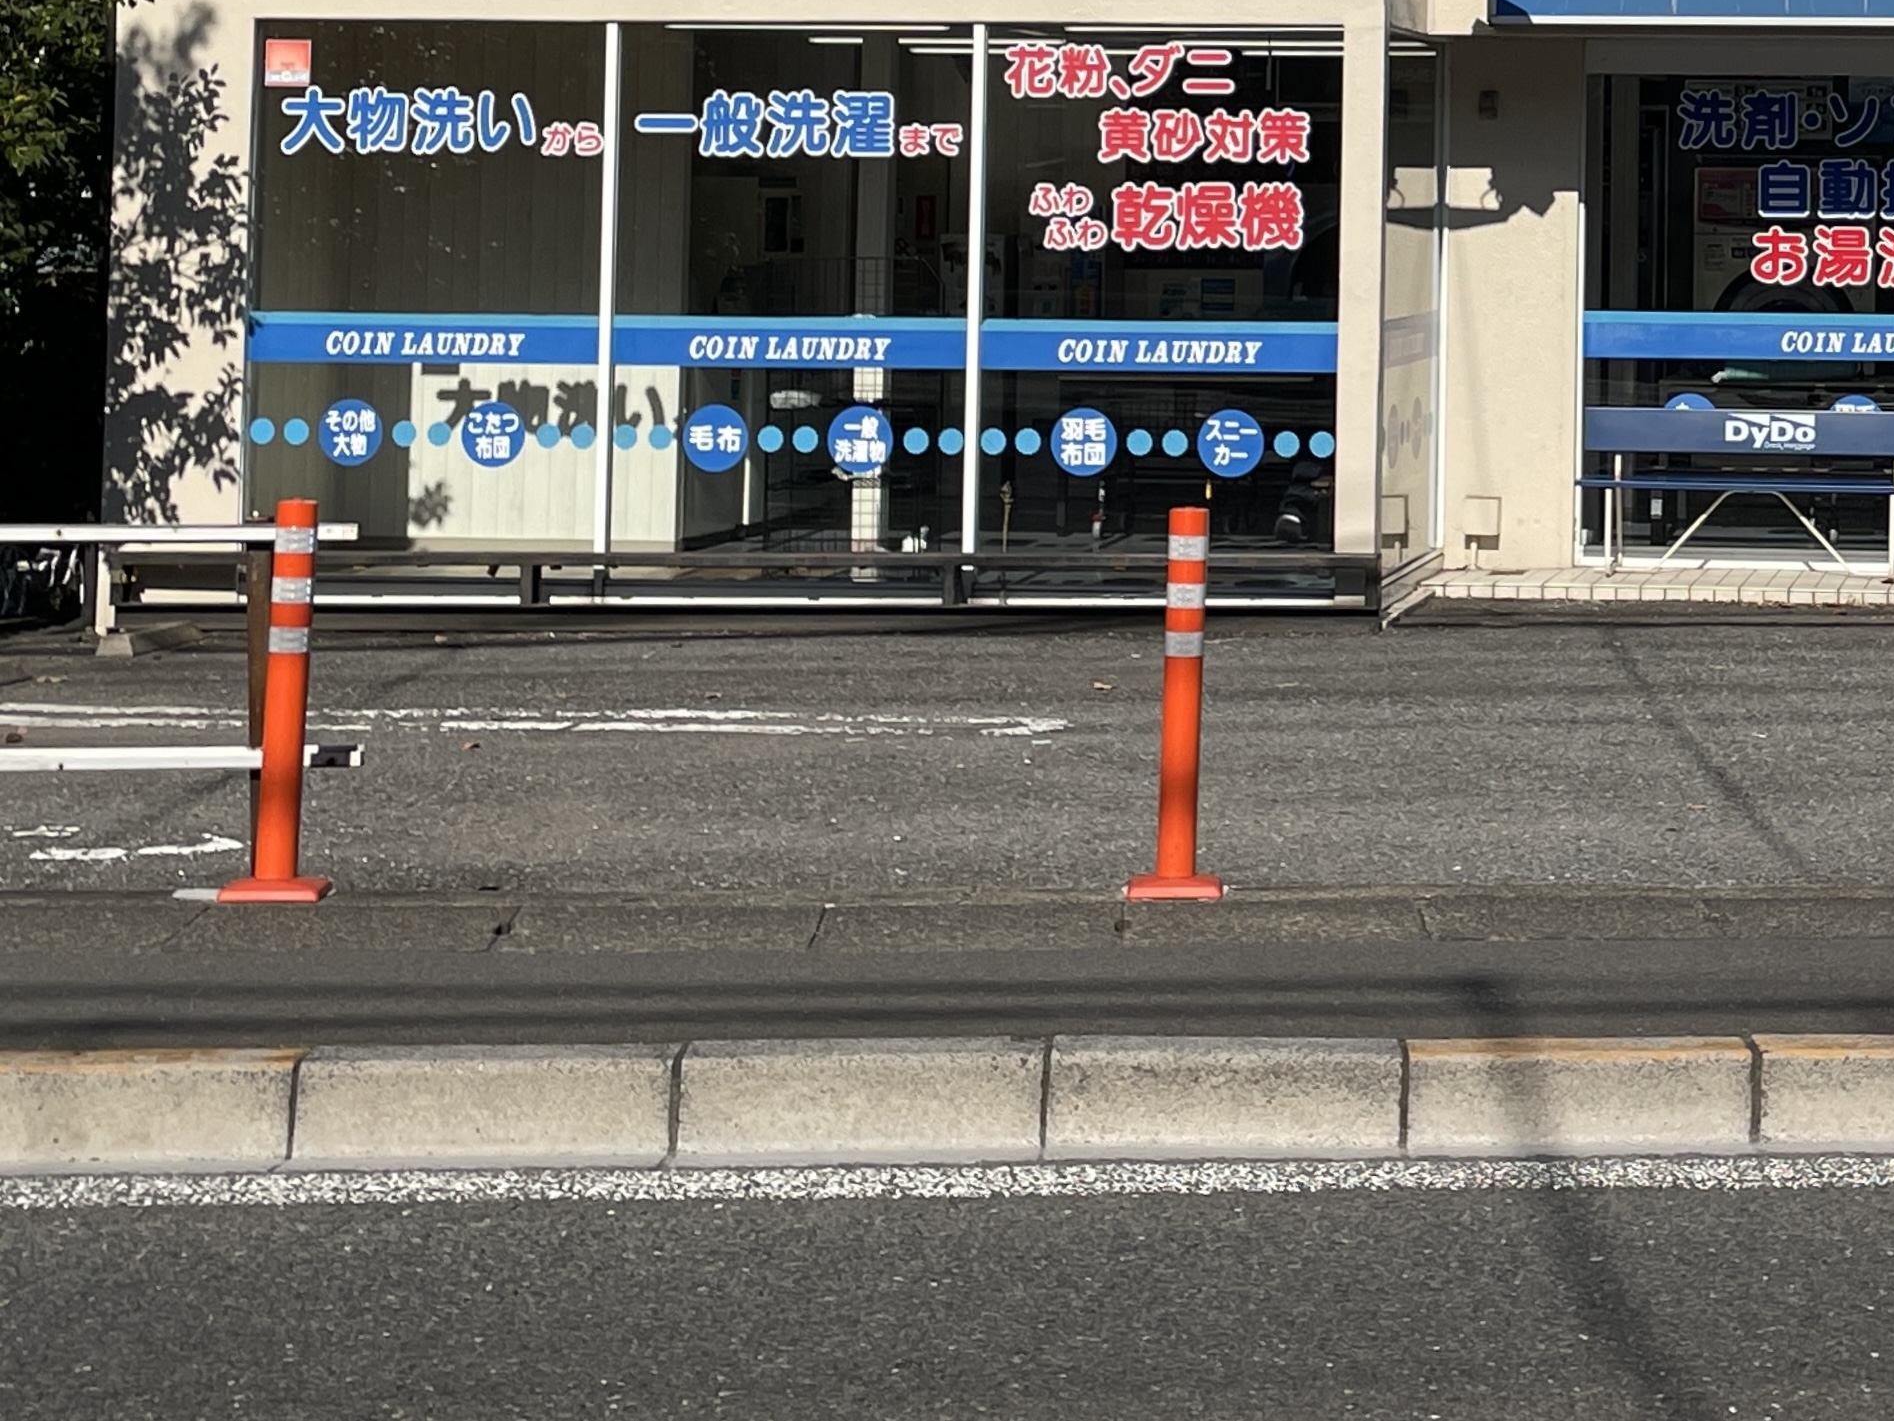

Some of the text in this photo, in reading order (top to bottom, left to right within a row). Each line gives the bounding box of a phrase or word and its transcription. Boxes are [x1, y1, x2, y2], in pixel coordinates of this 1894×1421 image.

[1005, 44, 1234, 100] 花粉、ダニ
[1099, 109, 1309, 164] 黄砂対策
[1030, 184, 1092, 214] ふわ
[1110, 182, 1303, 251] 乾燥機
[1044, 217, 1105, 251] ふわ
[325, 332, 525, 357] COIN LAUNDRY
[689, 335, 891, 361] COIN LAUNDRY
[1058, 340, 1262, 365] COIN LAUNDRY
[1780, 331, 1847, 354] COIN
[325, 410, 375, 433] その他
[467, 412, 519, 435] こたつ
[844, 416, 878, 439] 一般
[1061, 418, 1106, 441] 羽毛
[1206, 420, 1258, 441] スニー
[1725, 413, 1816, 449] DyDo
[333, 434, 367, 457] 大物
[475, 436, 510, 459] 布団
[690, 426, 741, 452] 毛布
[834, 439, 886, 464] 洗濯物
[1061, 442, 1106, 466] 布団
[1213, 444, 1248, 466] カー
